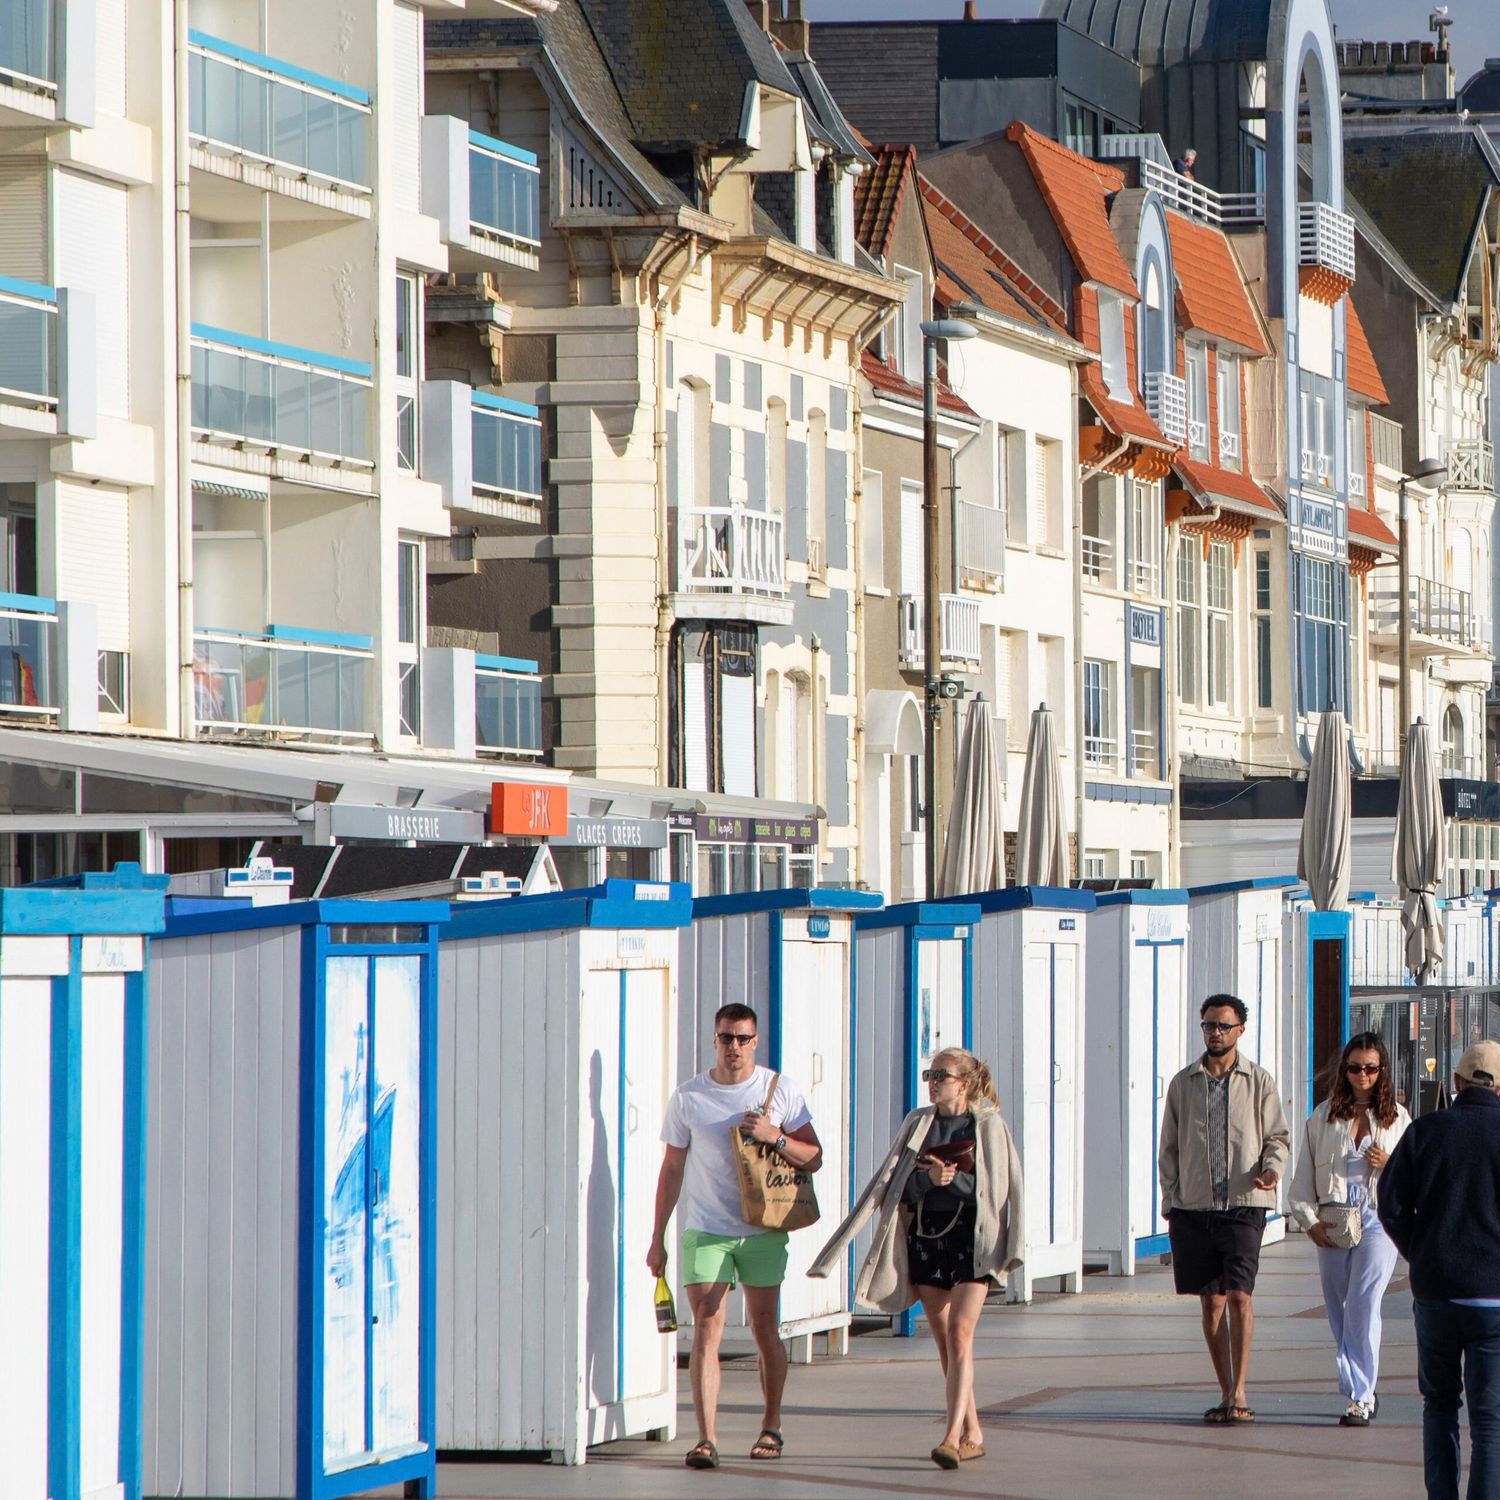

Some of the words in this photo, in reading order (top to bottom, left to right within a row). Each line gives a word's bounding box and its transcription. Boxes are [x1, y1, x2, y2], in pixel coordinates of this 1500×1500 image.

[1301, 502, 1333, 531] ATLANTIC
[1132, 611, 1156, 642] HOTEL
[528, 789, 551, 831] JFK
[388, 815, 440, 839] BRASSERIE
[576, 824, 607, 844] GLACES
[612, 821, 642, 846] CRÊPES
